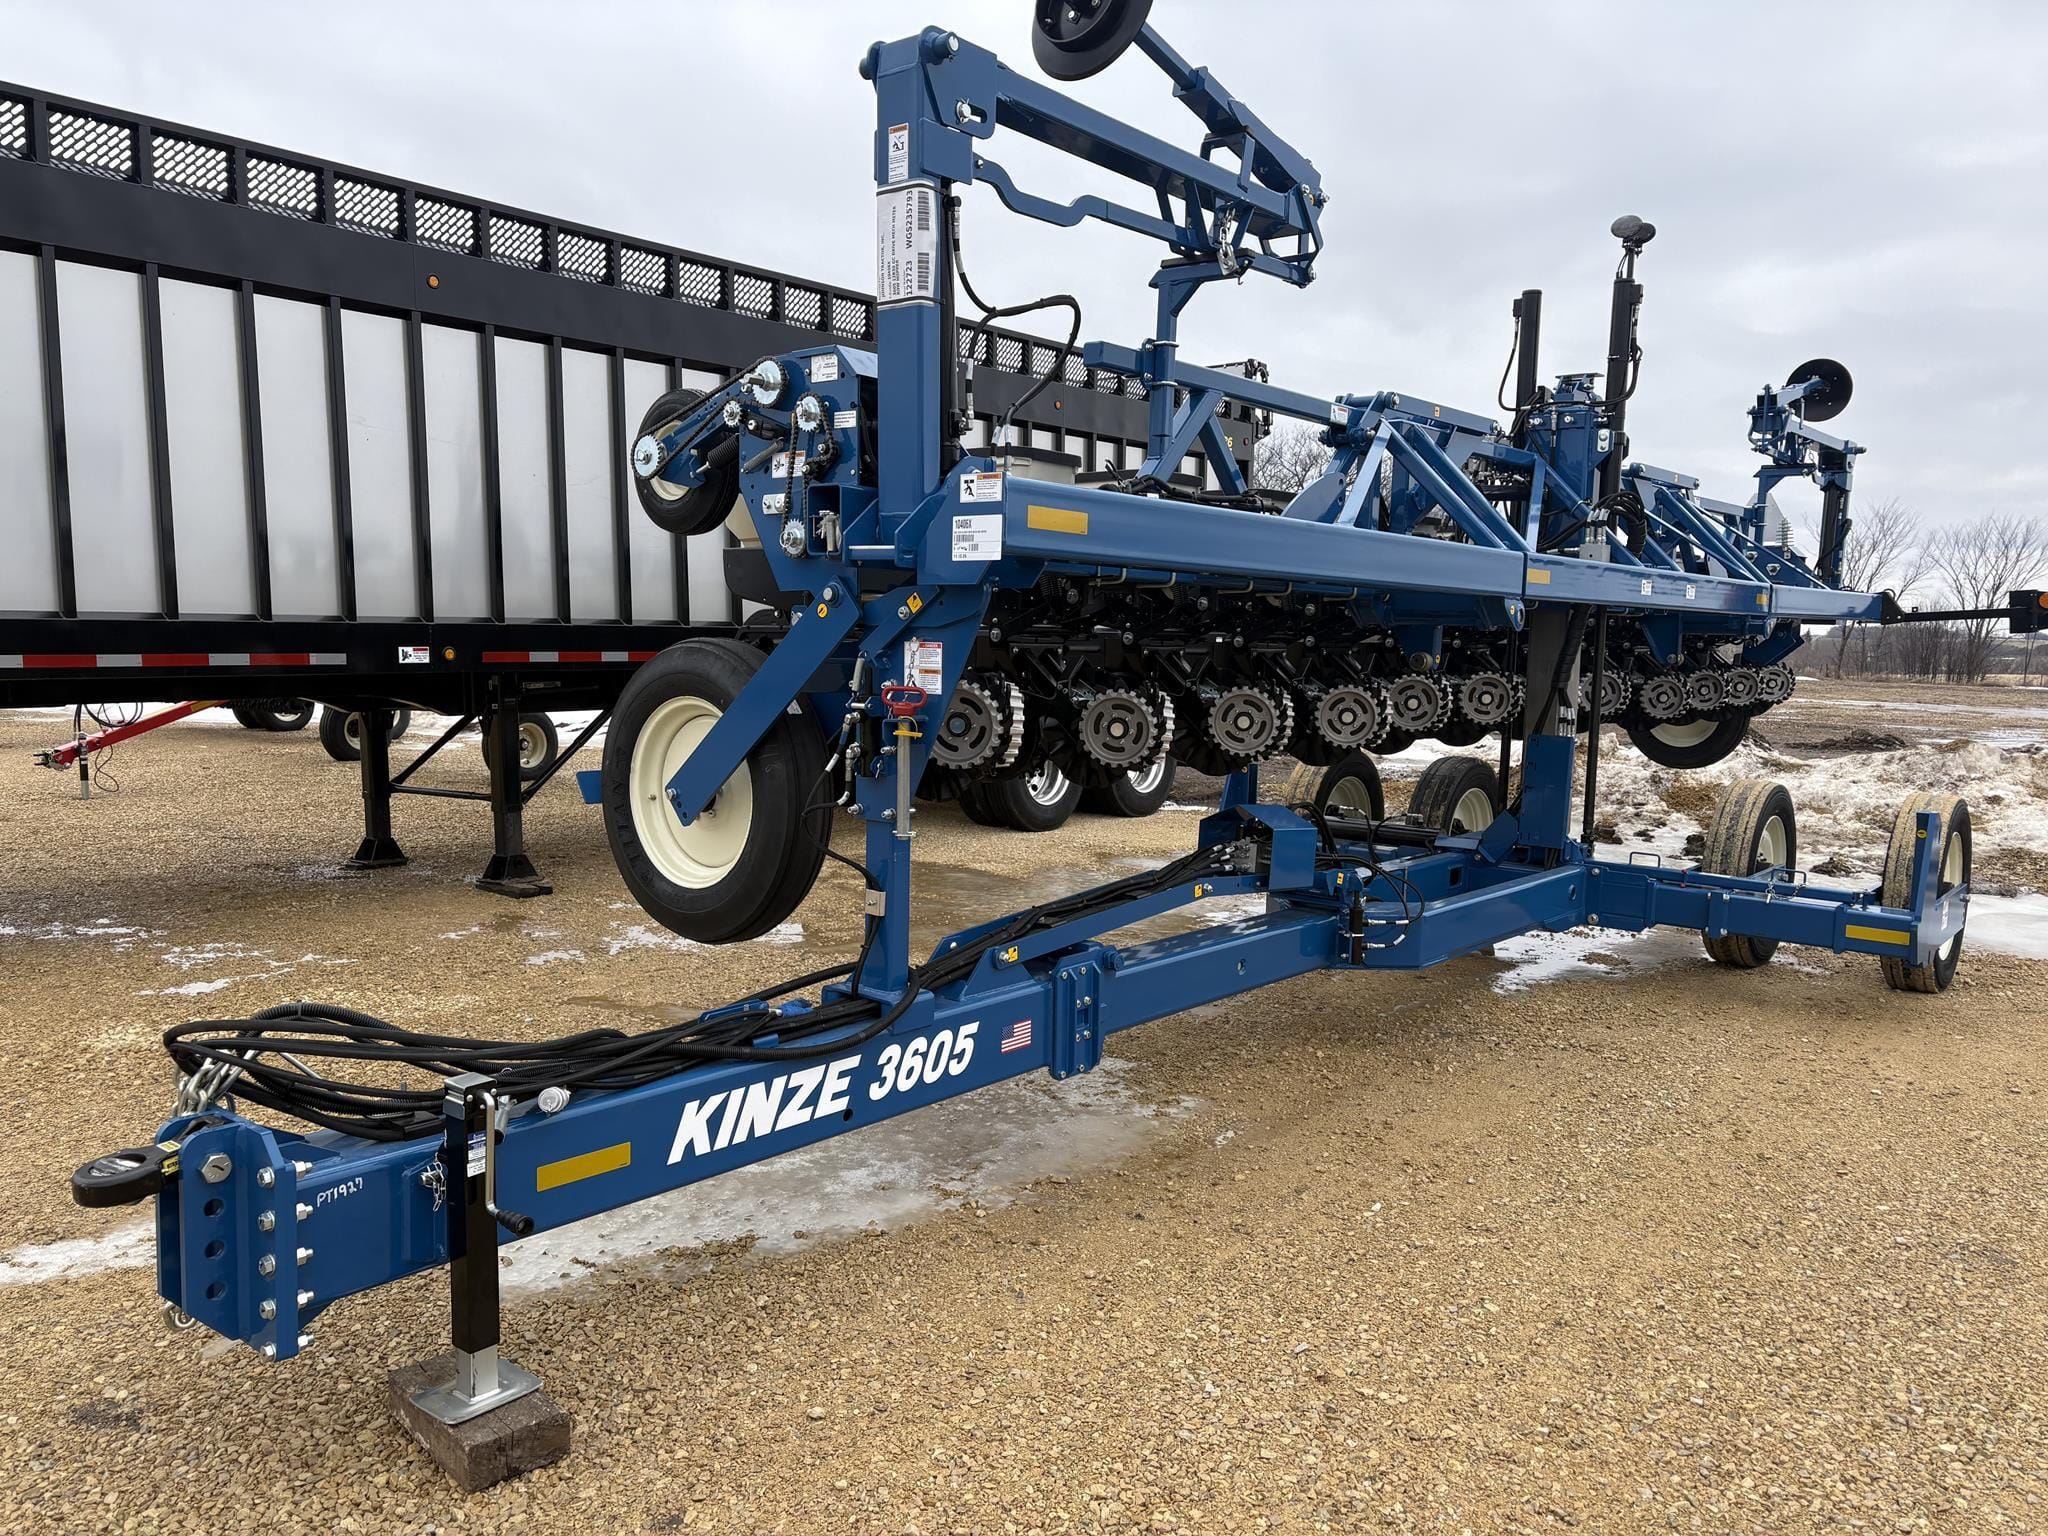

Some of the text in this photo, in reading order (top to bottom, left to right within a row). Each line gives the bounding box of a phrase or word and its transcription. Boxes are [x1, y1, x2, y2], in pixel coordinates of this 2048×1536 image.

[905, 190, 913, 296] 122723 WGS235793
[666, 1021, 980, 1166] KINZE 3605
[316, 1177, 363, 1208] PT1927
